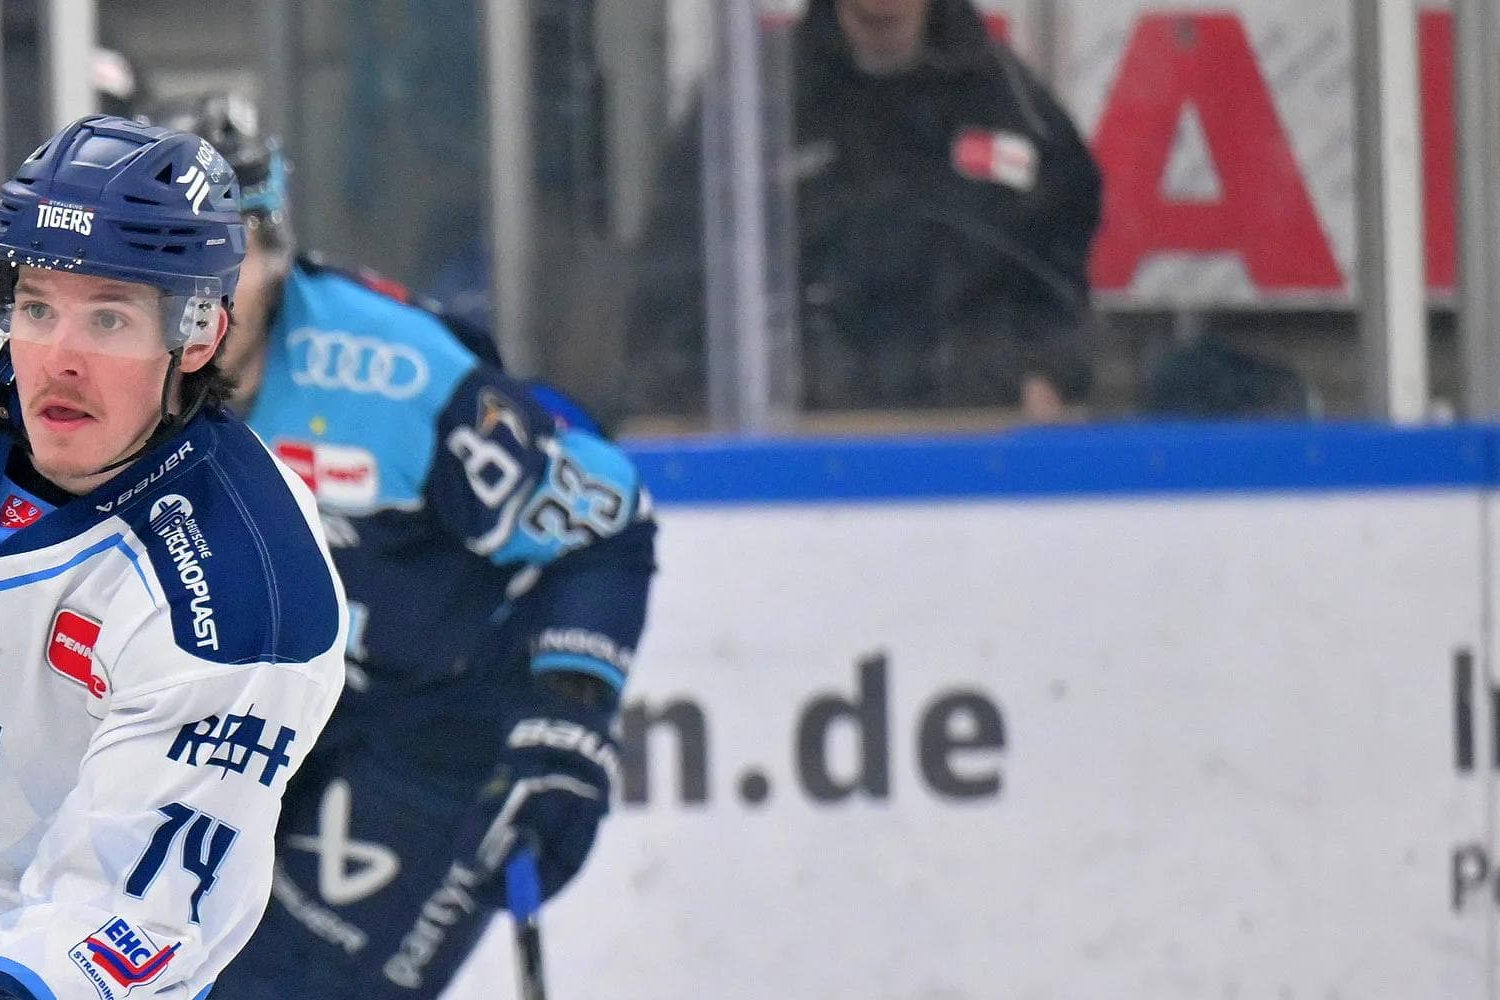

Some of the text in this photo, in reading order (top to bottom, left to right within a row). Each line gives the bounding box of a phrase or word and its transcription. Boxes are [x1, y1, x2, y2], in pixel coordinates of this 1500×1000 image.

[36, 204, 95, 237] TIGERS
[185, 518, 213, 560] DEUTSCHE
[162, 525, 220, 652] TECHNOPLAST
[54, 632, 94, 661] PENN
[617, 652, 1006, 808] n.de
[122, 799, 242, 927] 14
[104, 917, 151, 967] EHC
